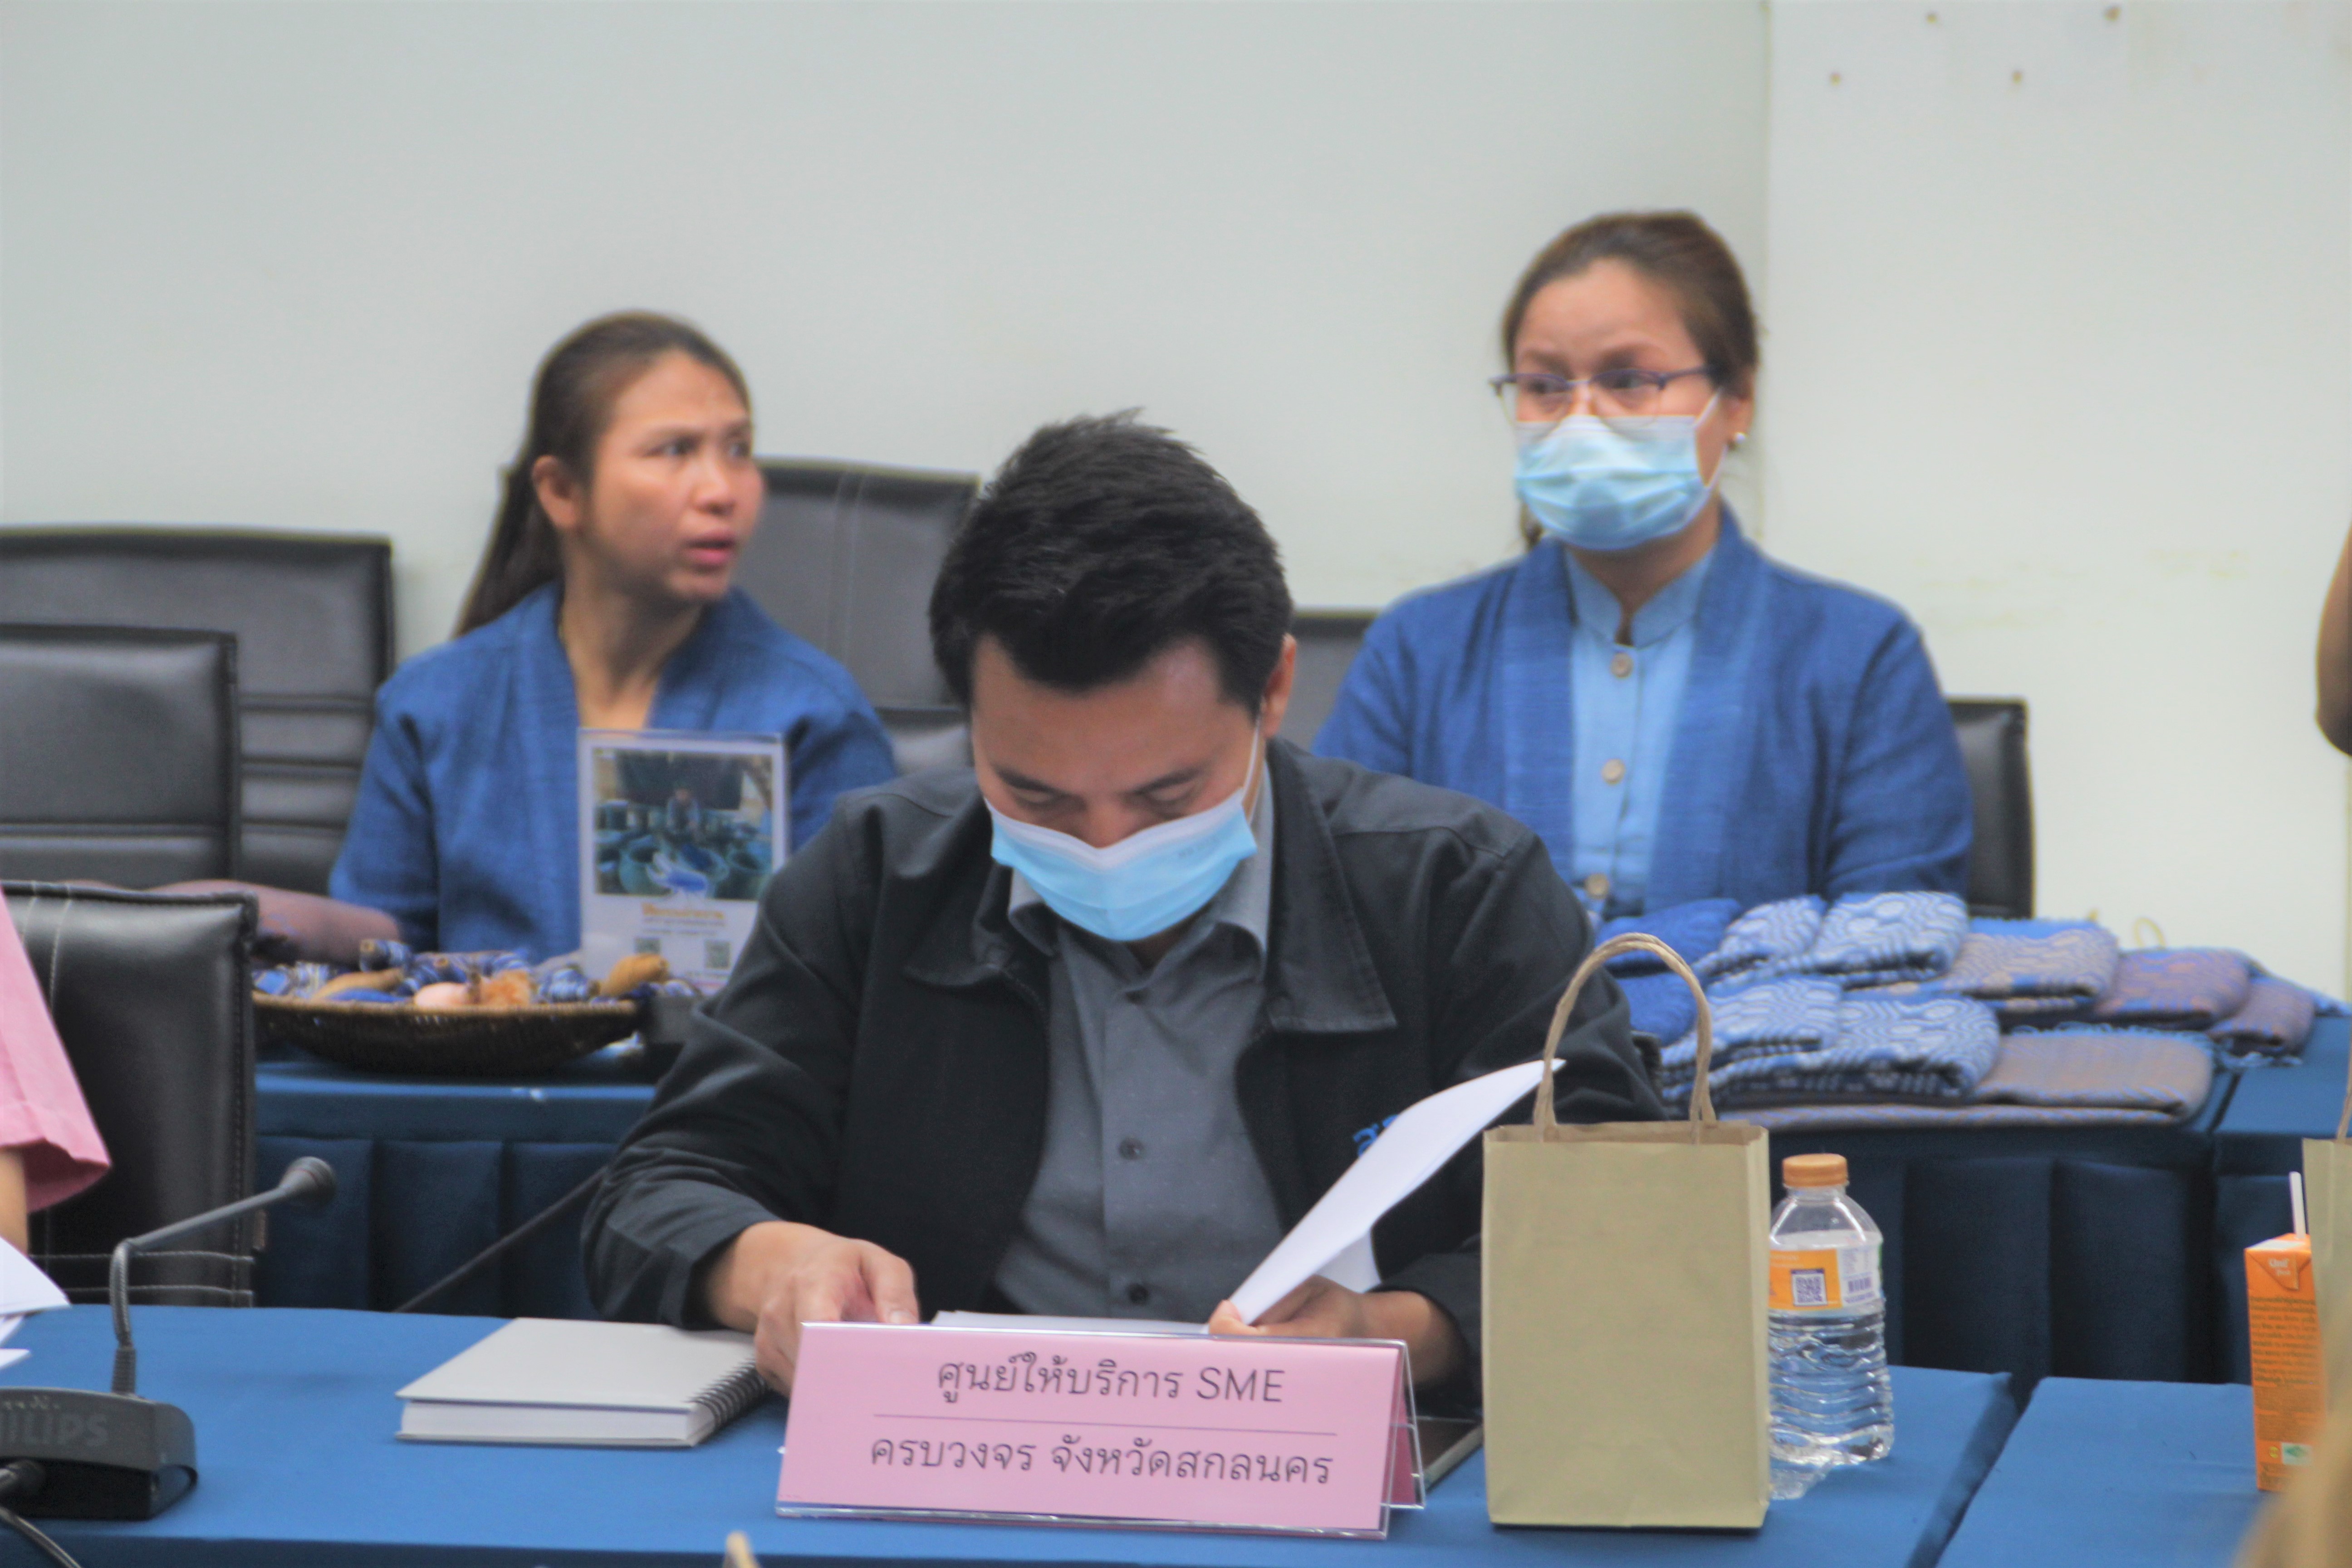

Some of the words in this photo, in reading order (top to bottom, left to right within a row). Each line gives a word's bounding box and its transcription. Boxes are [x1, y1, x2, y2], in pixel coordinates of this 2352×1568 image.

[937, 1350, 1184, 1405] ศูนย์ให้บริการ
[1195, 1366, 1286, 1404] SME
[0, 1411, 110, 1446] ILIPS
[870, 1438, 1037, 1472] ครบวงจร
[1050, 1433, 1334, 1485] จังหวัดสกลนคร
